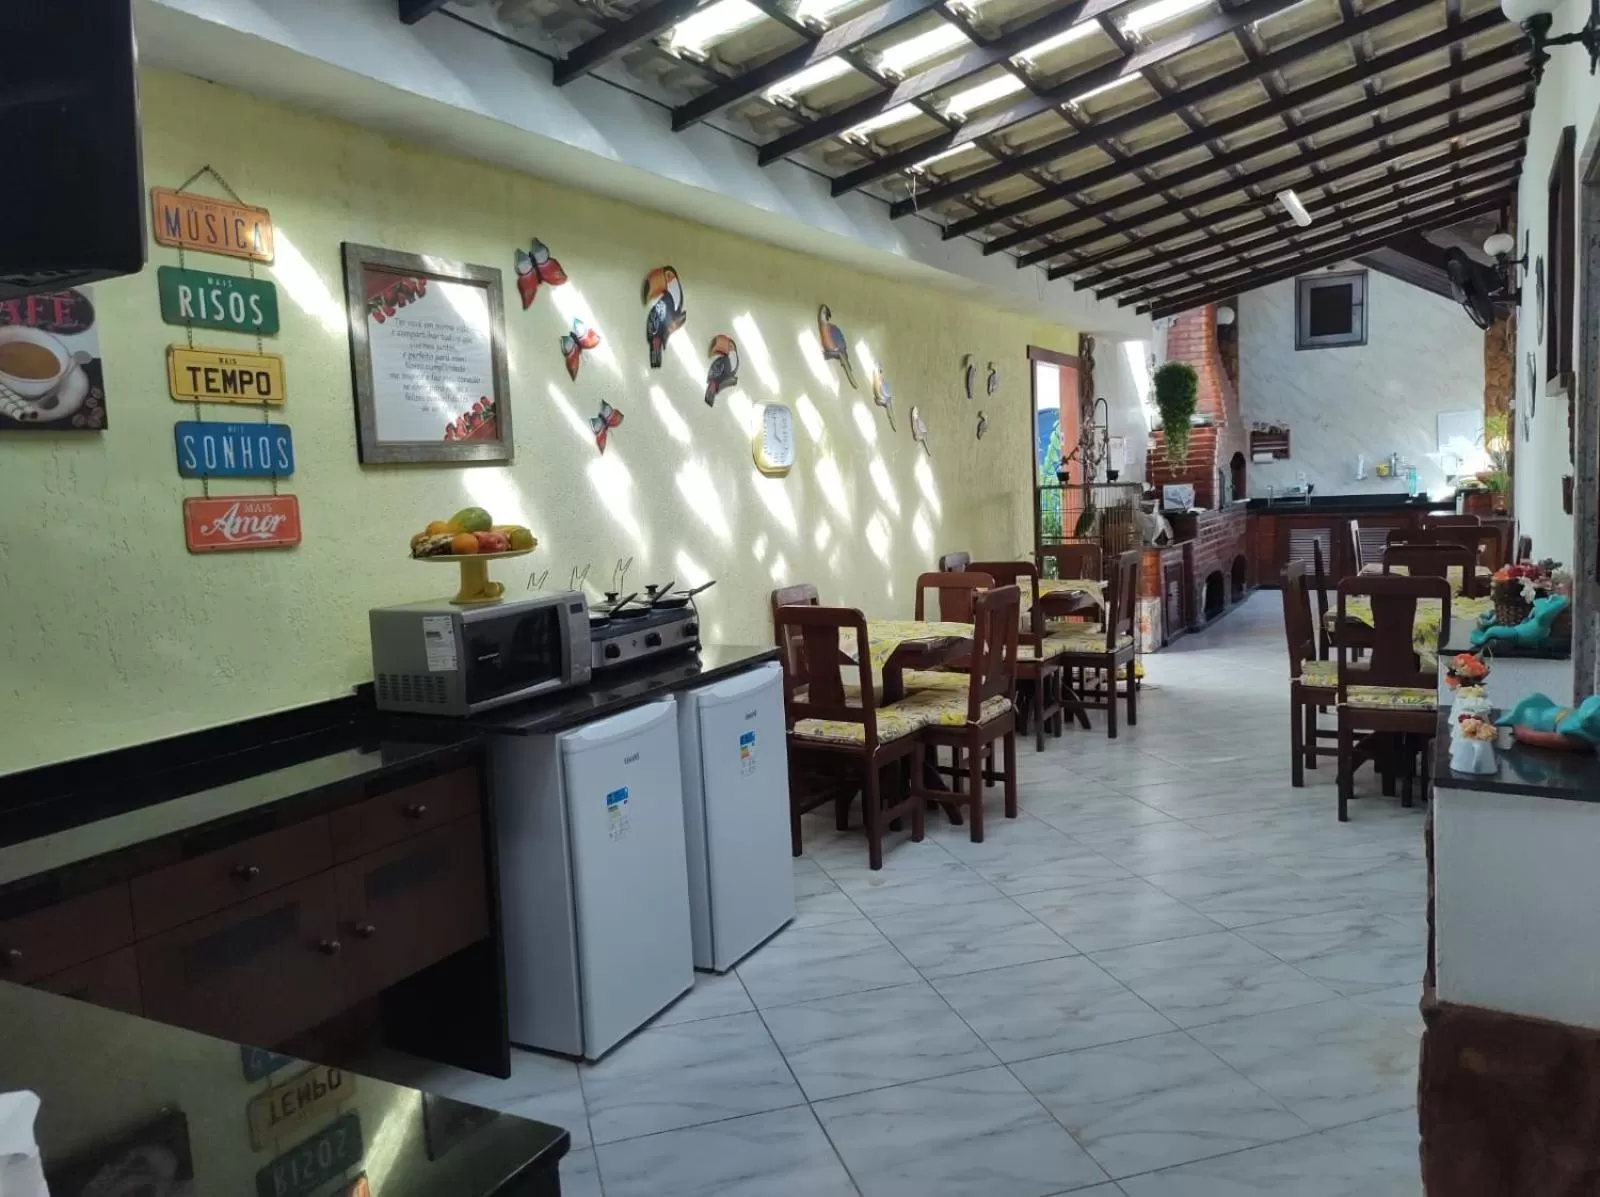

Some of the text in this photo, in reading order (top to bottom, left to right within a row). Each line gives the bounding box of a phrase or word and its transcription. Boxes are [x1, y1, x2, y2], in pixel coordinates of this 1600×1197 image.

[163, 204, 265, 253] MÚSICA
[178, 284, 264, 326] RISOS
[186, 366, 272, 396] TEMPO
[183, 435, 290, 470] SONHOS
[200, 500, 288, 541] Amor
[244, 503, 273, 513] MAIS
